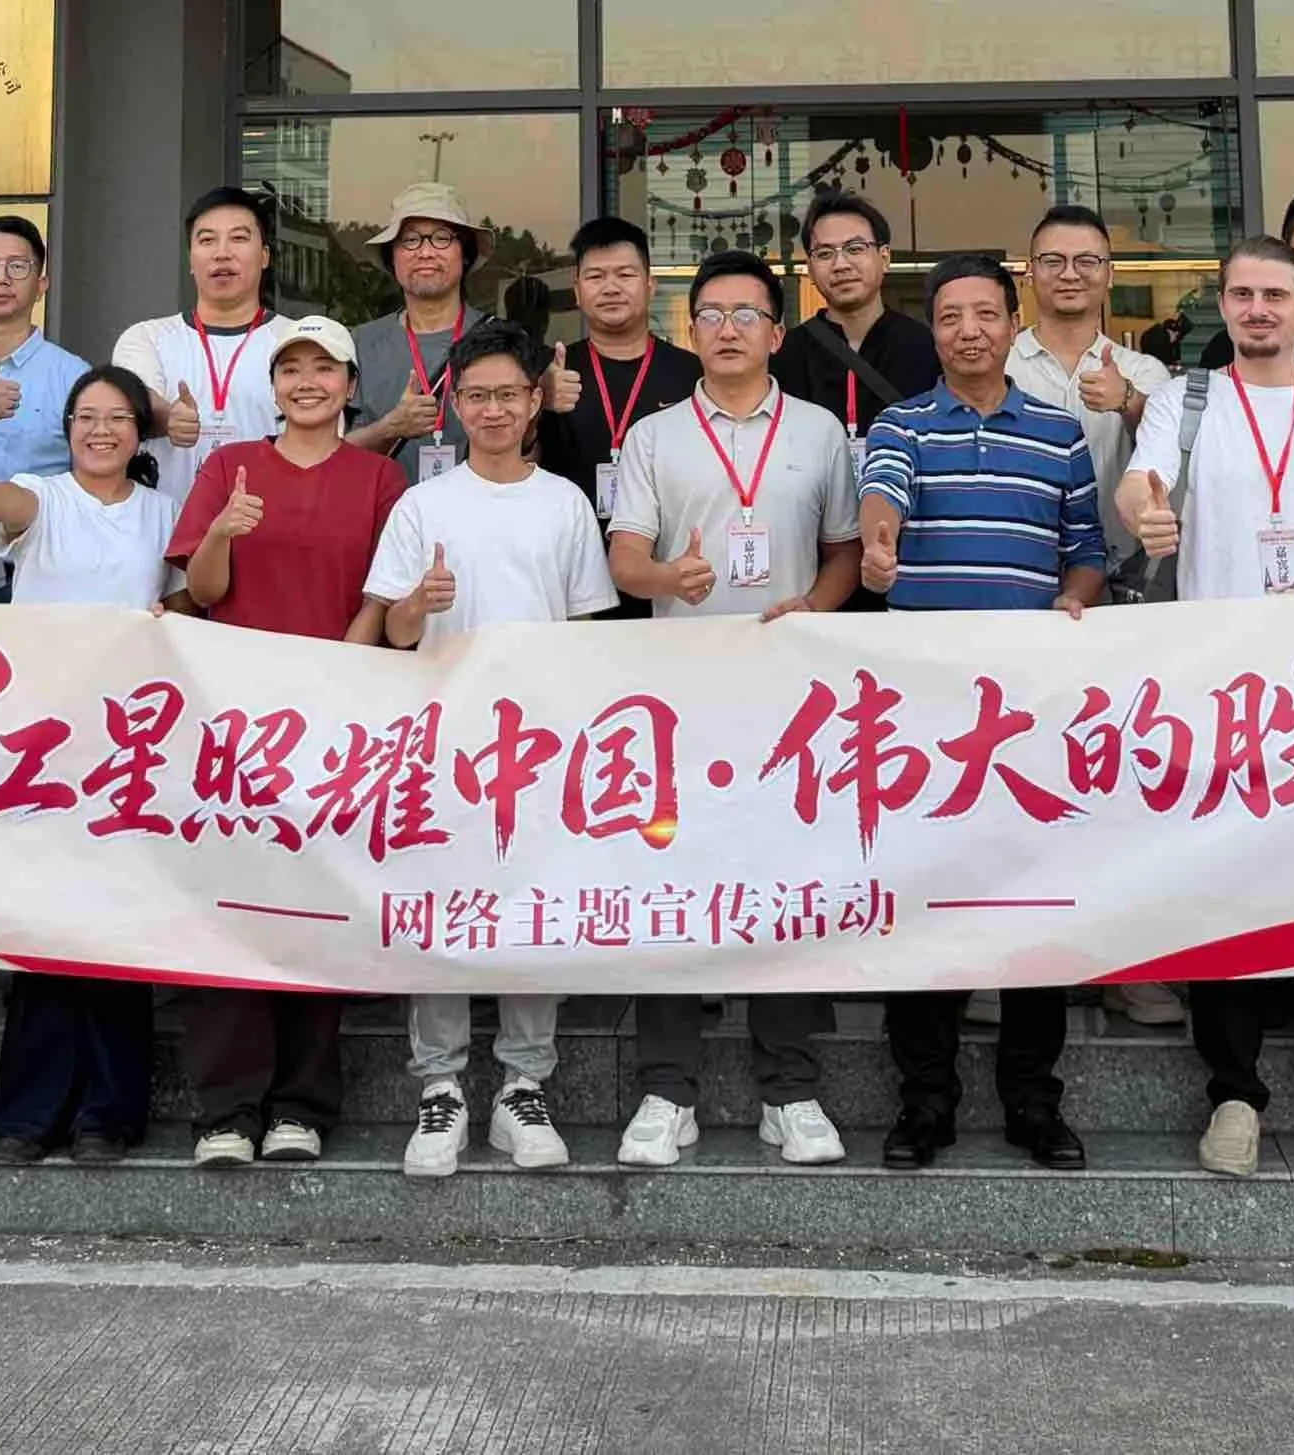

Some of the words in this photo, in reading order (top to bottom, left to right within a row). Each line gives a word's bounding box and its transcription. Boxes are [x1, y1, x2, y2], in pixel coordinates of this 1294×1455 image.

[381, 880, 897, 951] 网络主题宣传活动
